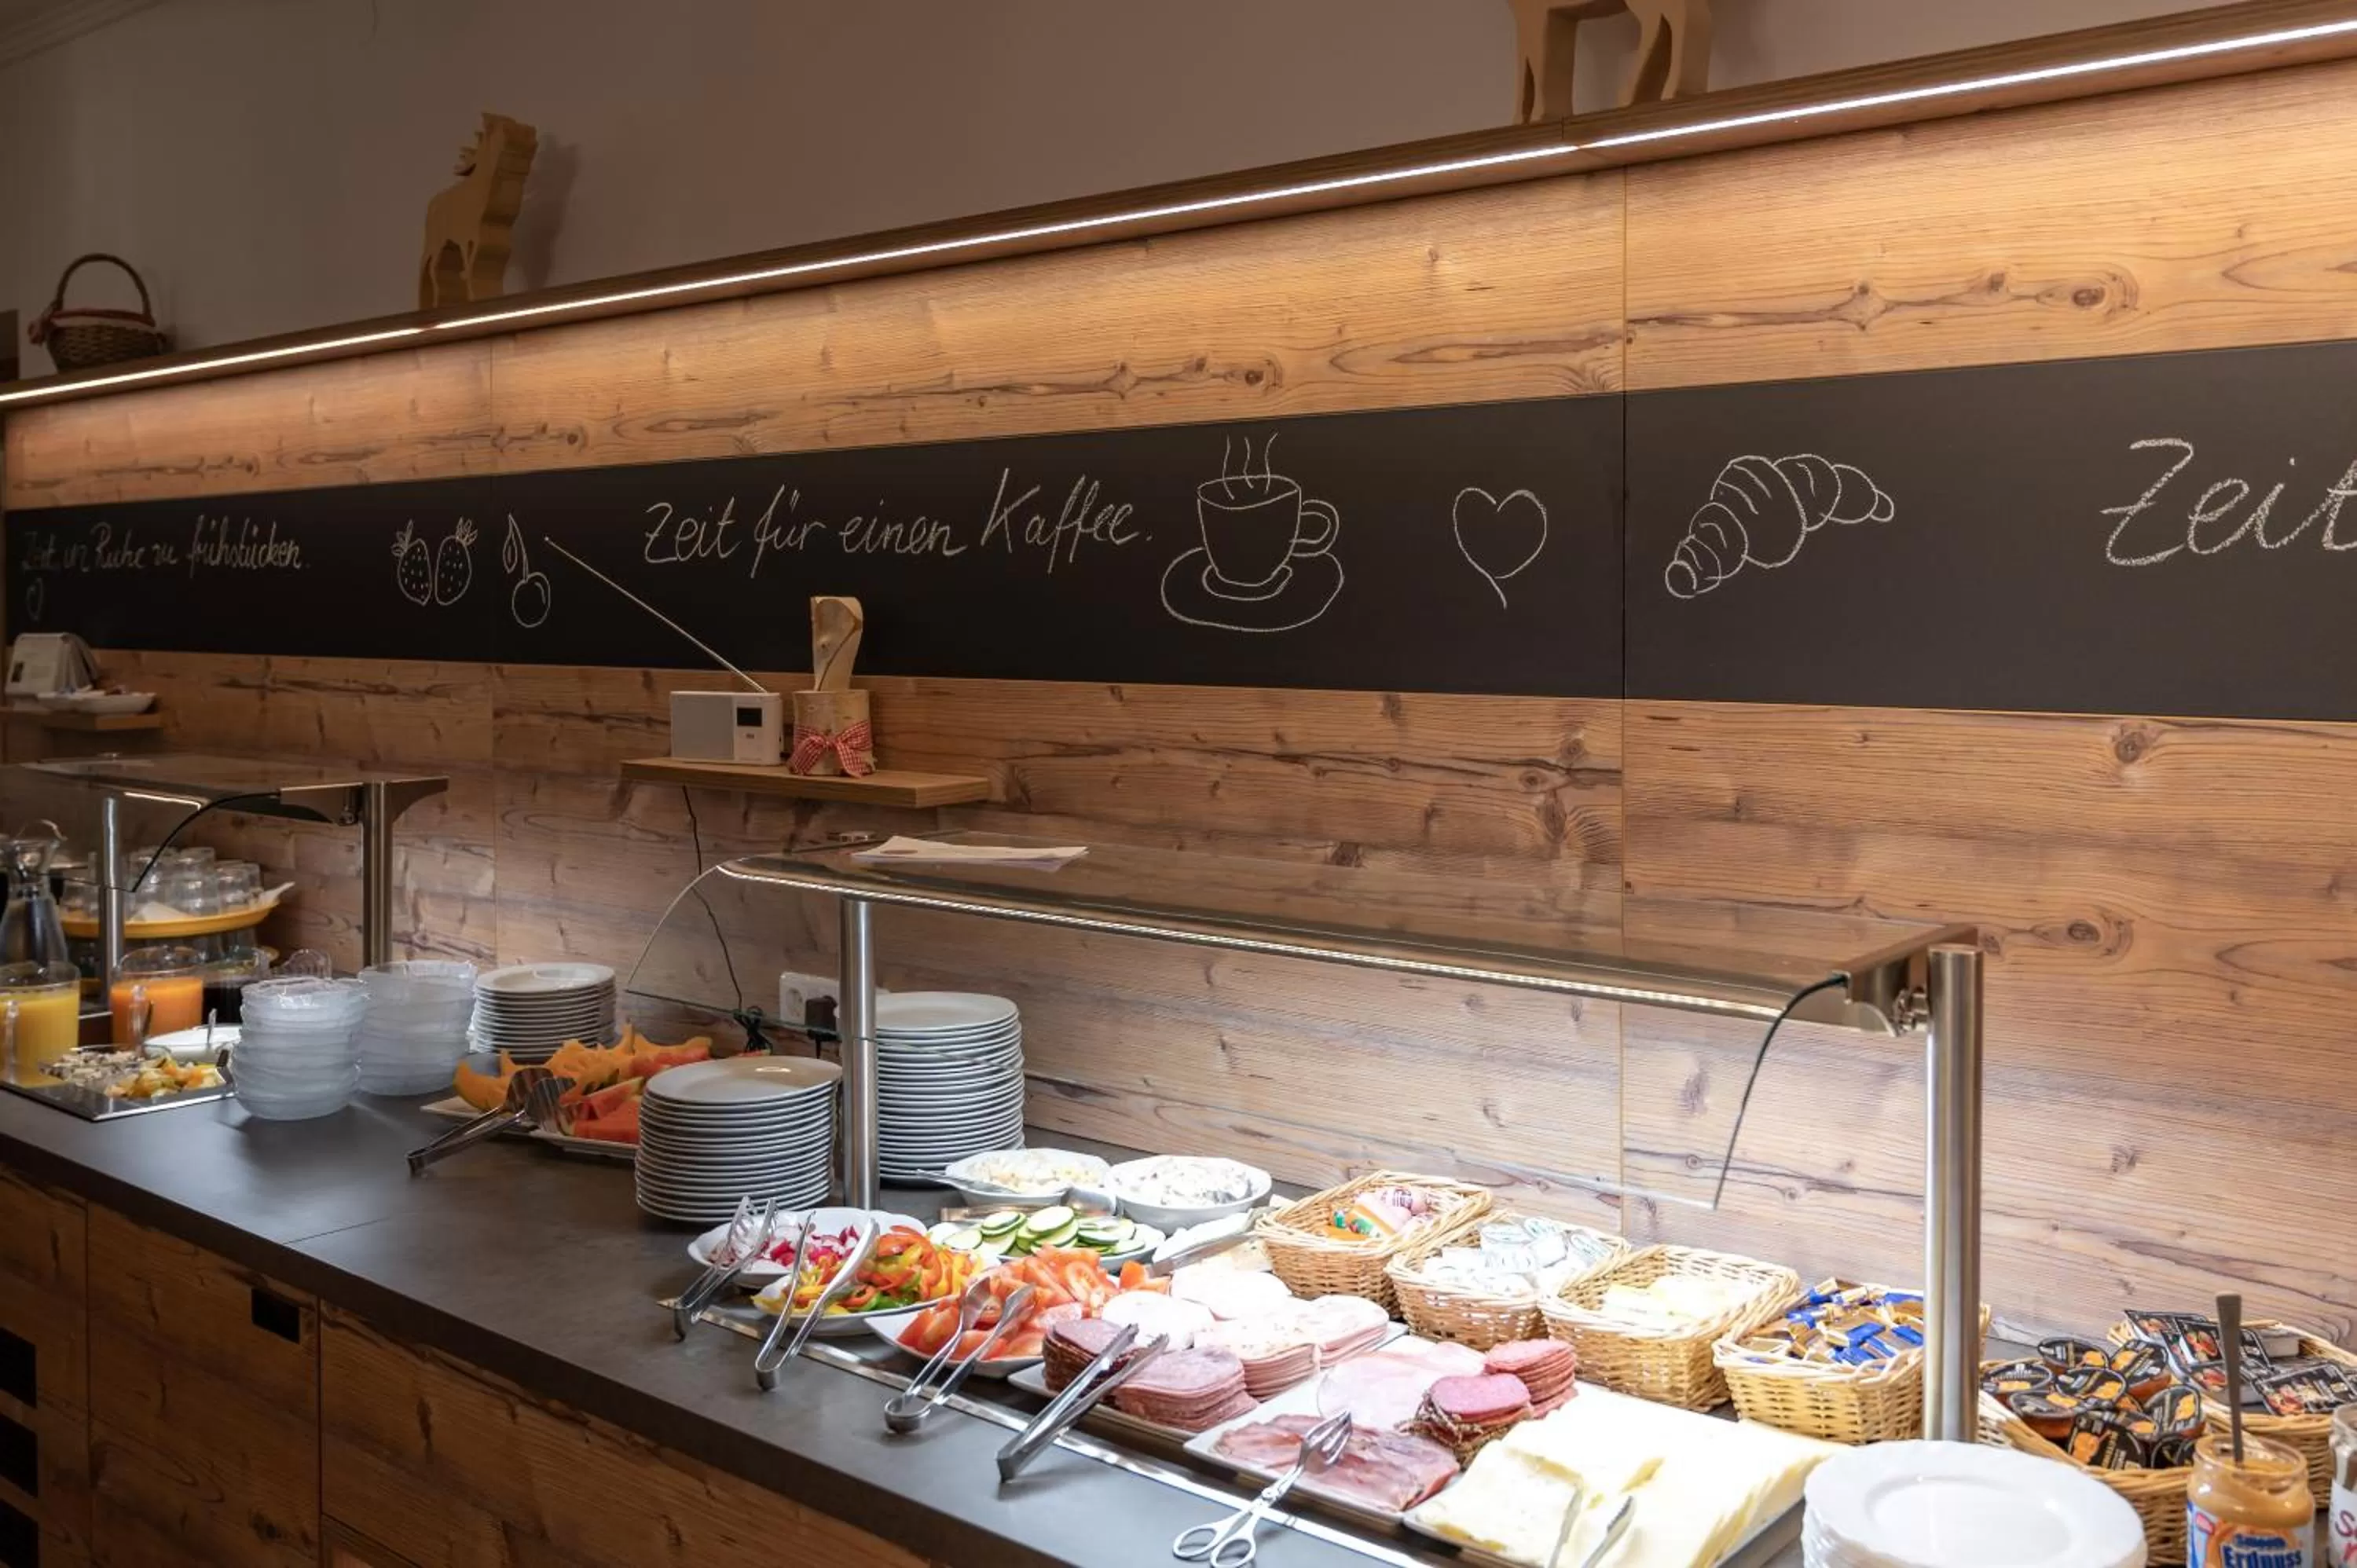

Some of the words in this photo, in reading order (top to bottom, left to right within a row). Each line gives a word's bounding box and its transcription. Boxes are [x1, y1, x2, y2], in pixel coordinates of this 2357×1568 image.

[643, 496, 742, 563] Zeit
[751, 484, 827, 578] für
[838, 500, 969, 556] einen
